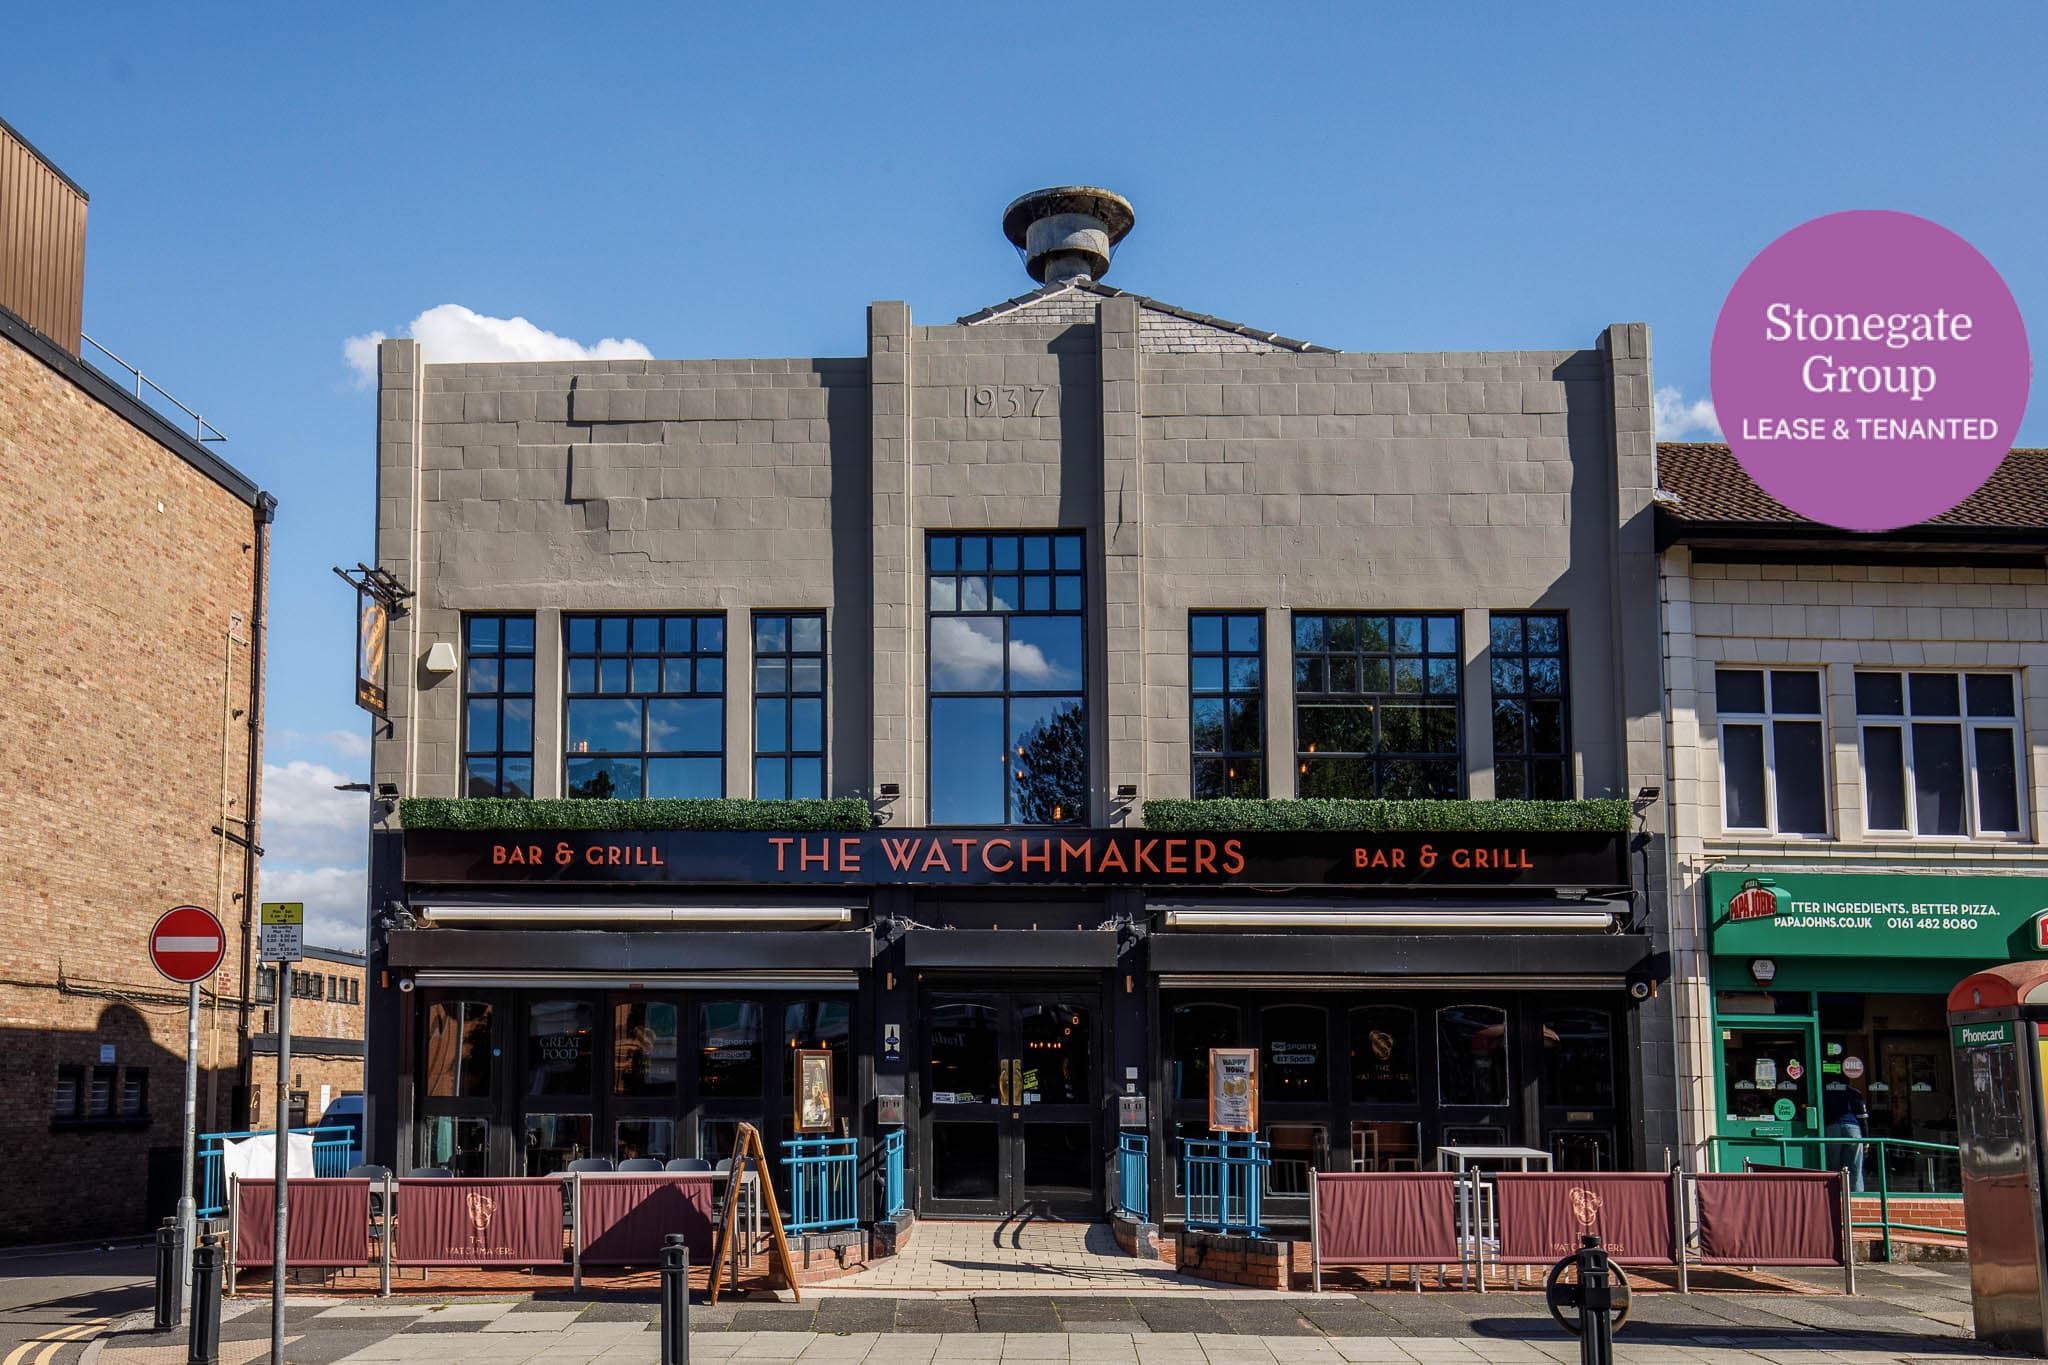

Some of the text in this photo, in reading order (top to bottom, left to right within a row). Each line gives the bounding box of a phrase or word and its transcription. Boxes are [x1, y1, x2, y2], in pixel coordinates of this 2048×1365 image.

[964, 386, 1048, 418] 1937
[492, 842, 665, 865] BAR & GRILL
[768, 836, 1246, 874] THE WATCHMAKERS
[1354, 844, 1534, 868] BAR & GRILL
[1791, 901, 2001, 916] TTER INGREDIENTS. BETTER PIZZA.
[1774, 916, 1978, 930] PAPAJOHNS.CO.UK 0161 482 8080
[539, 1037, 581, 1048] GREAT
[1962, 1025, 2004, 1043] Phonecard
[543, 1048, 578, 1060] FOOD
